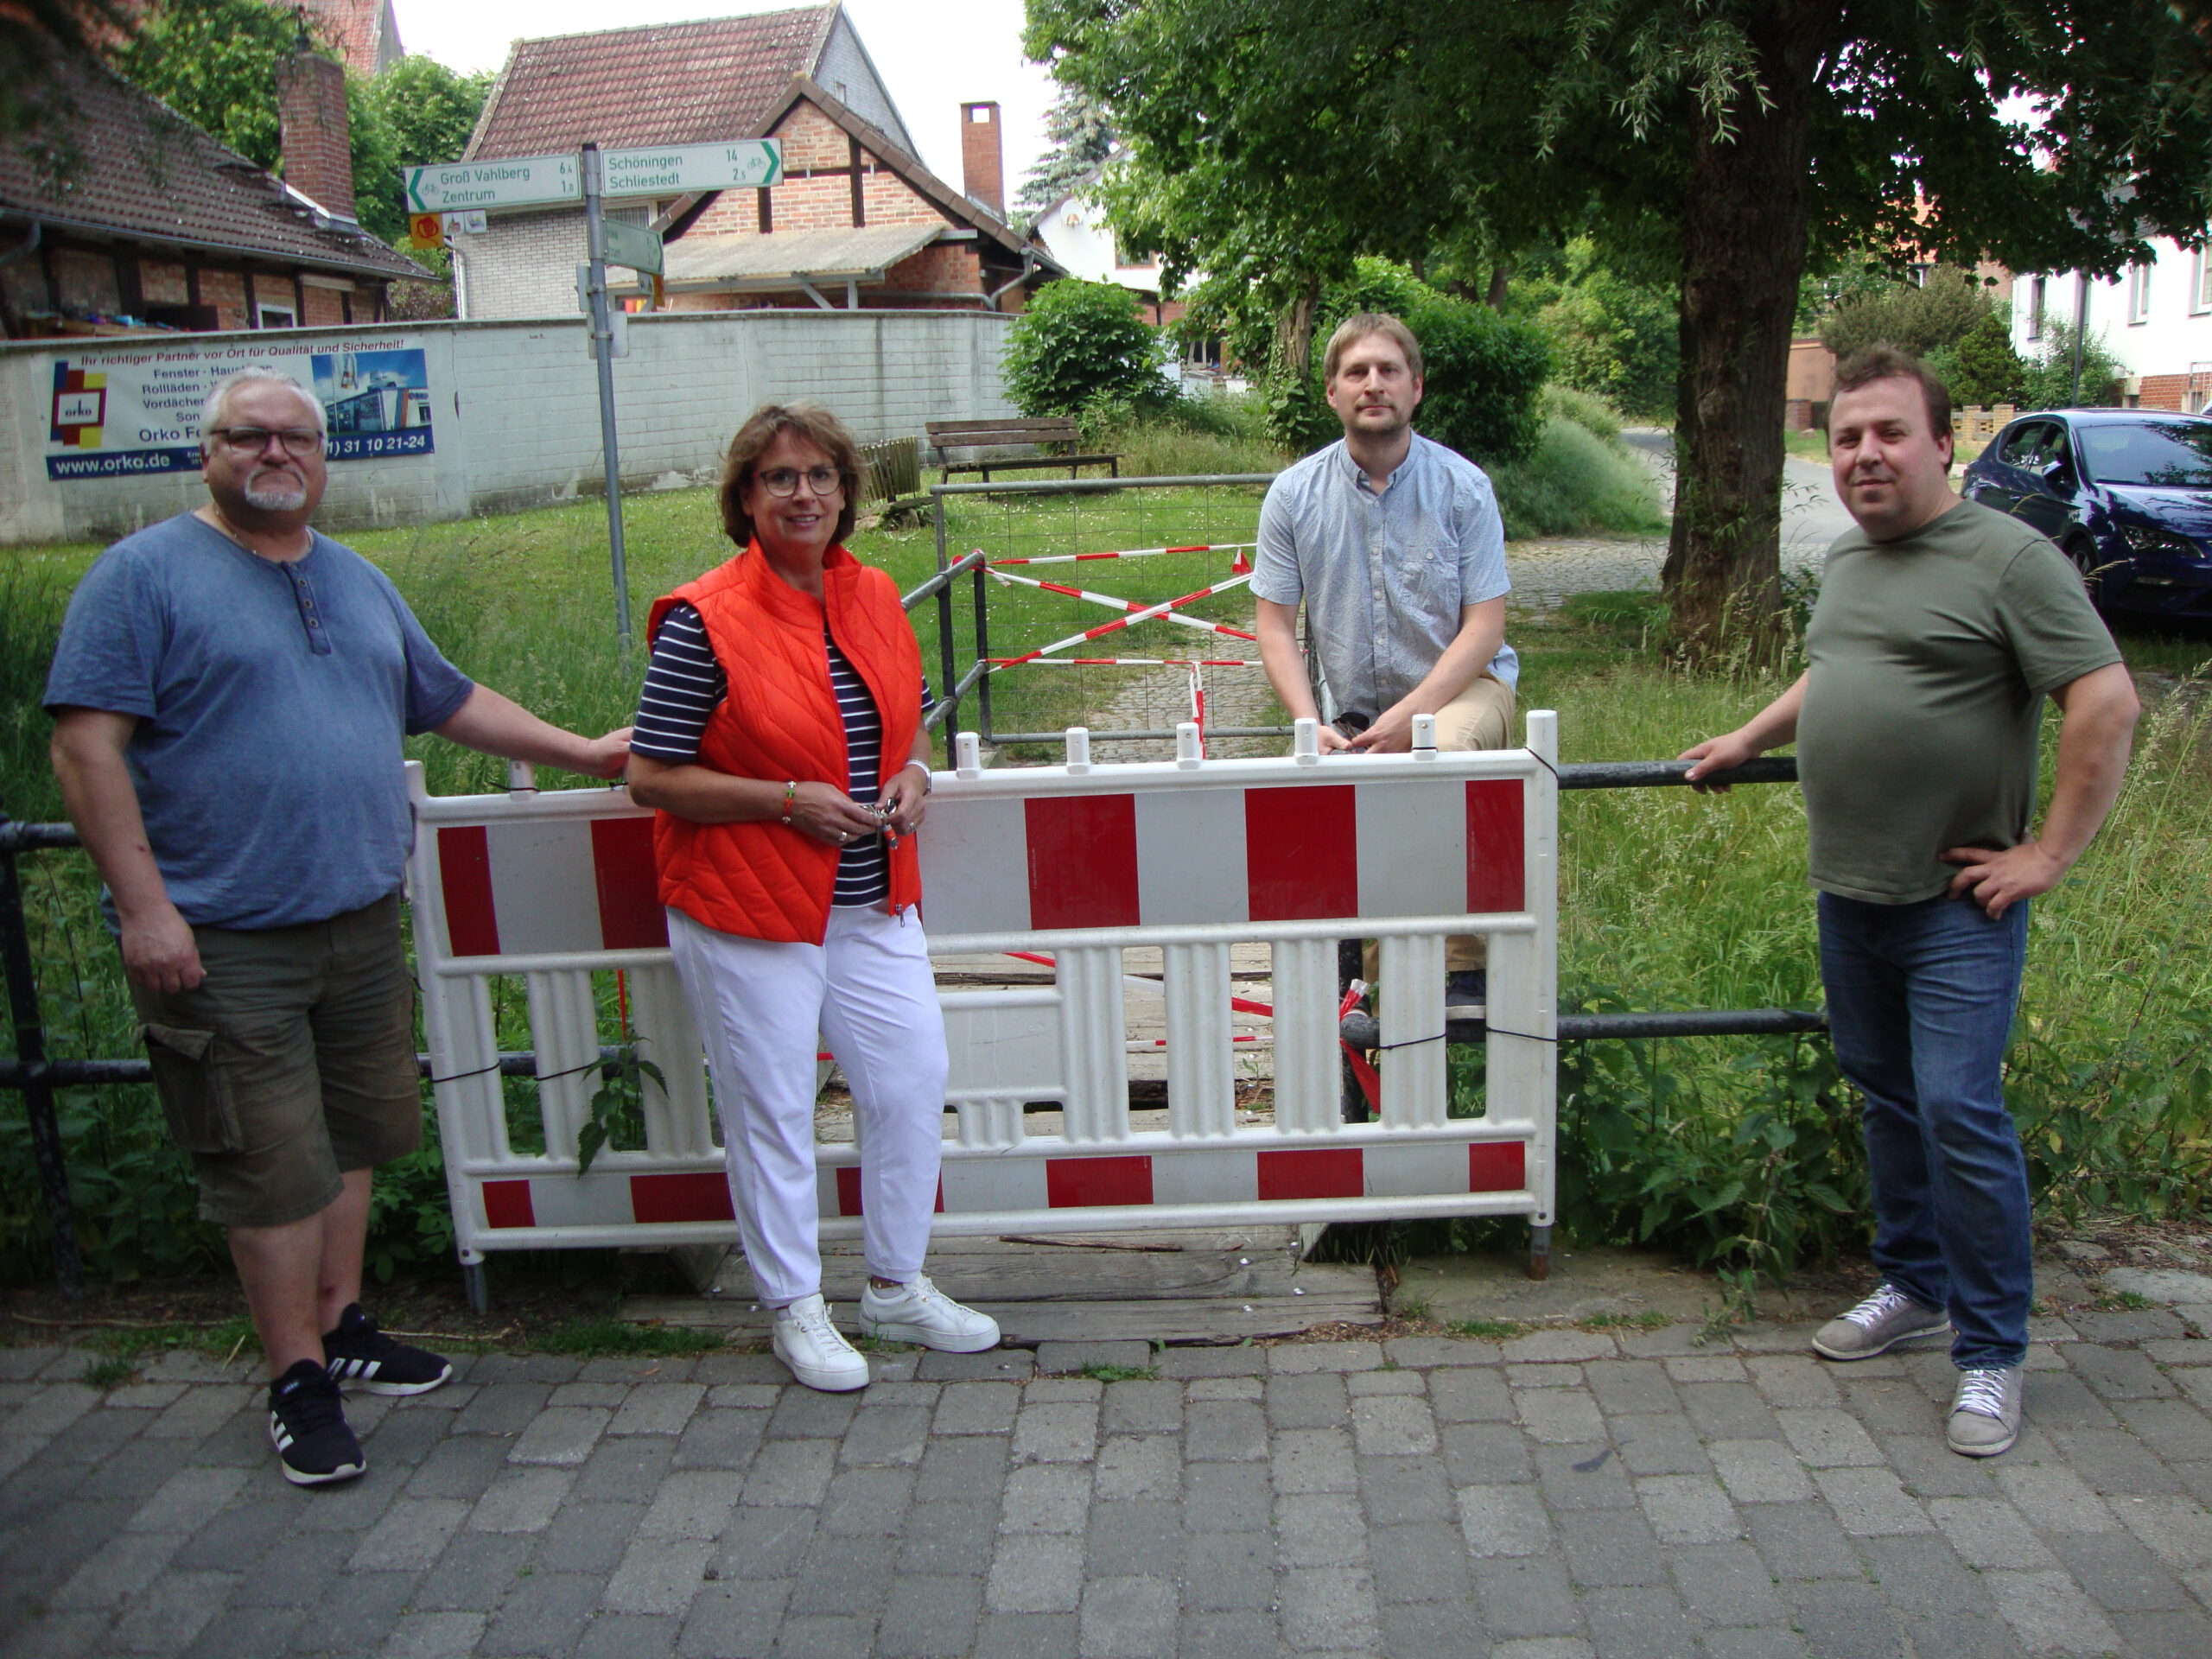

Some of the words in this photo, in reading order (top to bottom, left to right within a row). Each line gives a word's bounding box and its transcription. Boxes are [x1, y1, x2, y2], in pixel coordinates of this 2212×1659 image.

[608, 155, 683, 170] Schöningen
[726, 149, 738, 162] 14
[441, 172, 470, 185] Groß
[475, 167, 531, 182] Vahlberg
[609, 172, 680, 189] Schliestedt
[442, 189, 495, 203] Zentrum
[81, 355, 98, 366] Ihr
[101, 354, 152, 366] richtiger
[156, 352, 200, 363] Partner
[204, 352, 223, 360] vor
[226, 347, 245, 359] Ort
[249, 346, 265, 358] für
[269, 344, 314, 356] Qualität
[317, 341, 340, 354] und
[342, 340, 404, 353] Sicherheit!
[154, 369, 200, 378] Fenster
[143, 382, 200, 395] Rollläden
[65, 400, 92, 417] orko
[143, 397, 206, 409] Vordächer
[140, 429, 180, 442] Orko
[344, 440, 360, 454] 31
[366, 437, 383, 451] 10
[386, 435, 425, 449] 21-24
[55, 453, 170, 475] www.orko.de
